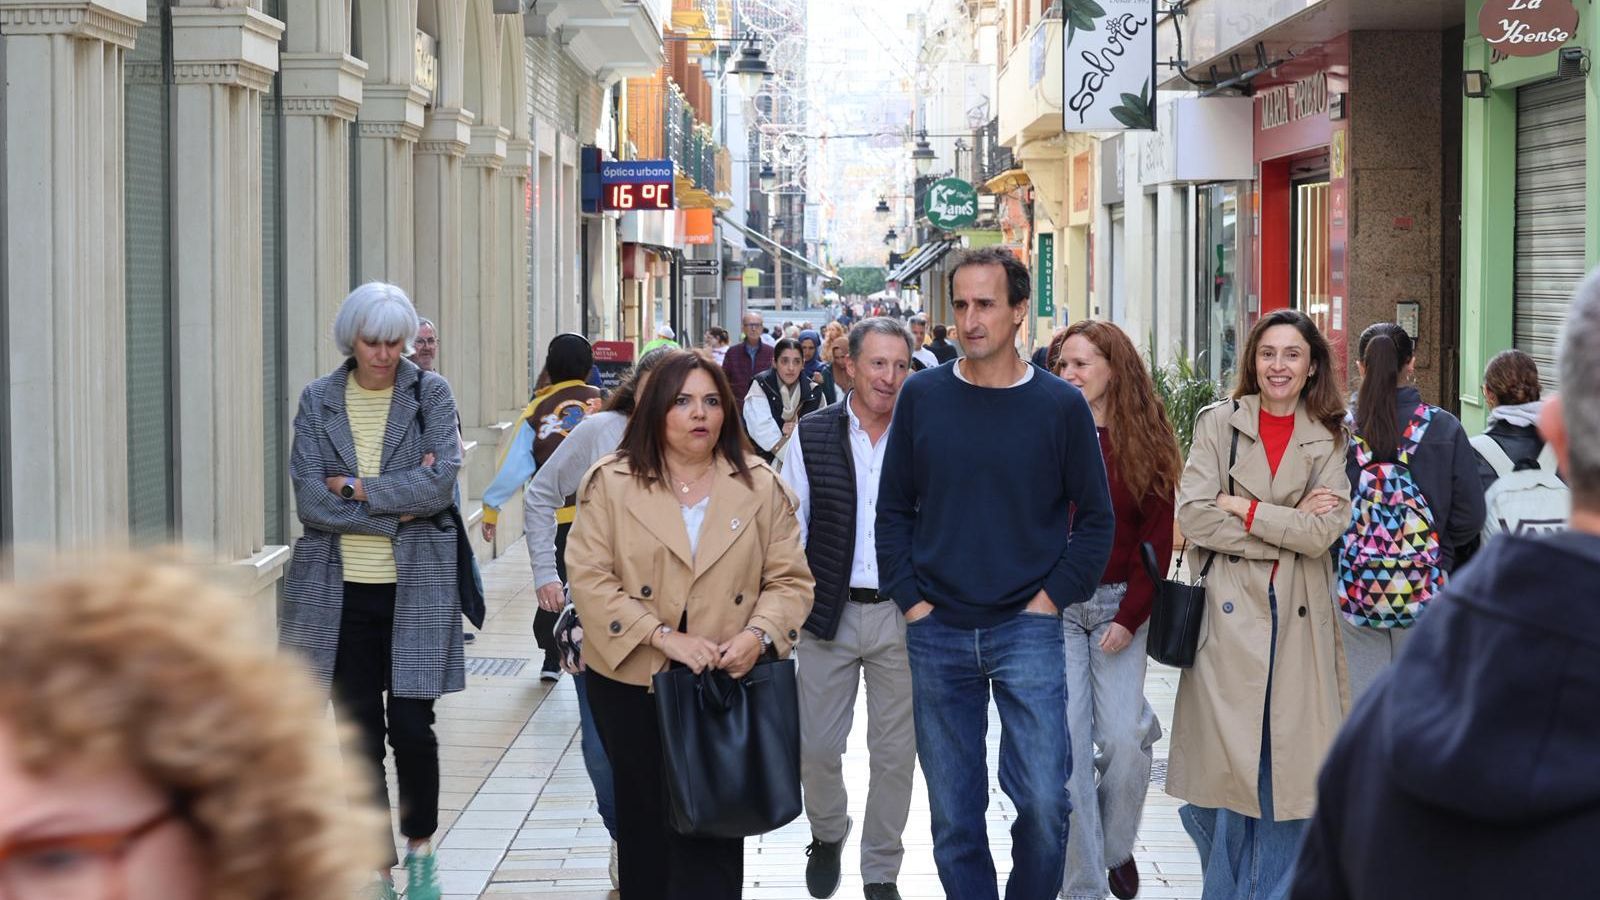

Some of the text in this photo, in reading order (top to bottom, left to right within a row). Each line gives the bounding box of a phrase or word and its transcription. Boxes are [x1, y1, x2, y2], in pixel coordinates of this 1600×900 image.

[603, 166, 671, 178] óptica urbano
[612, 184, 632, 208] 16
